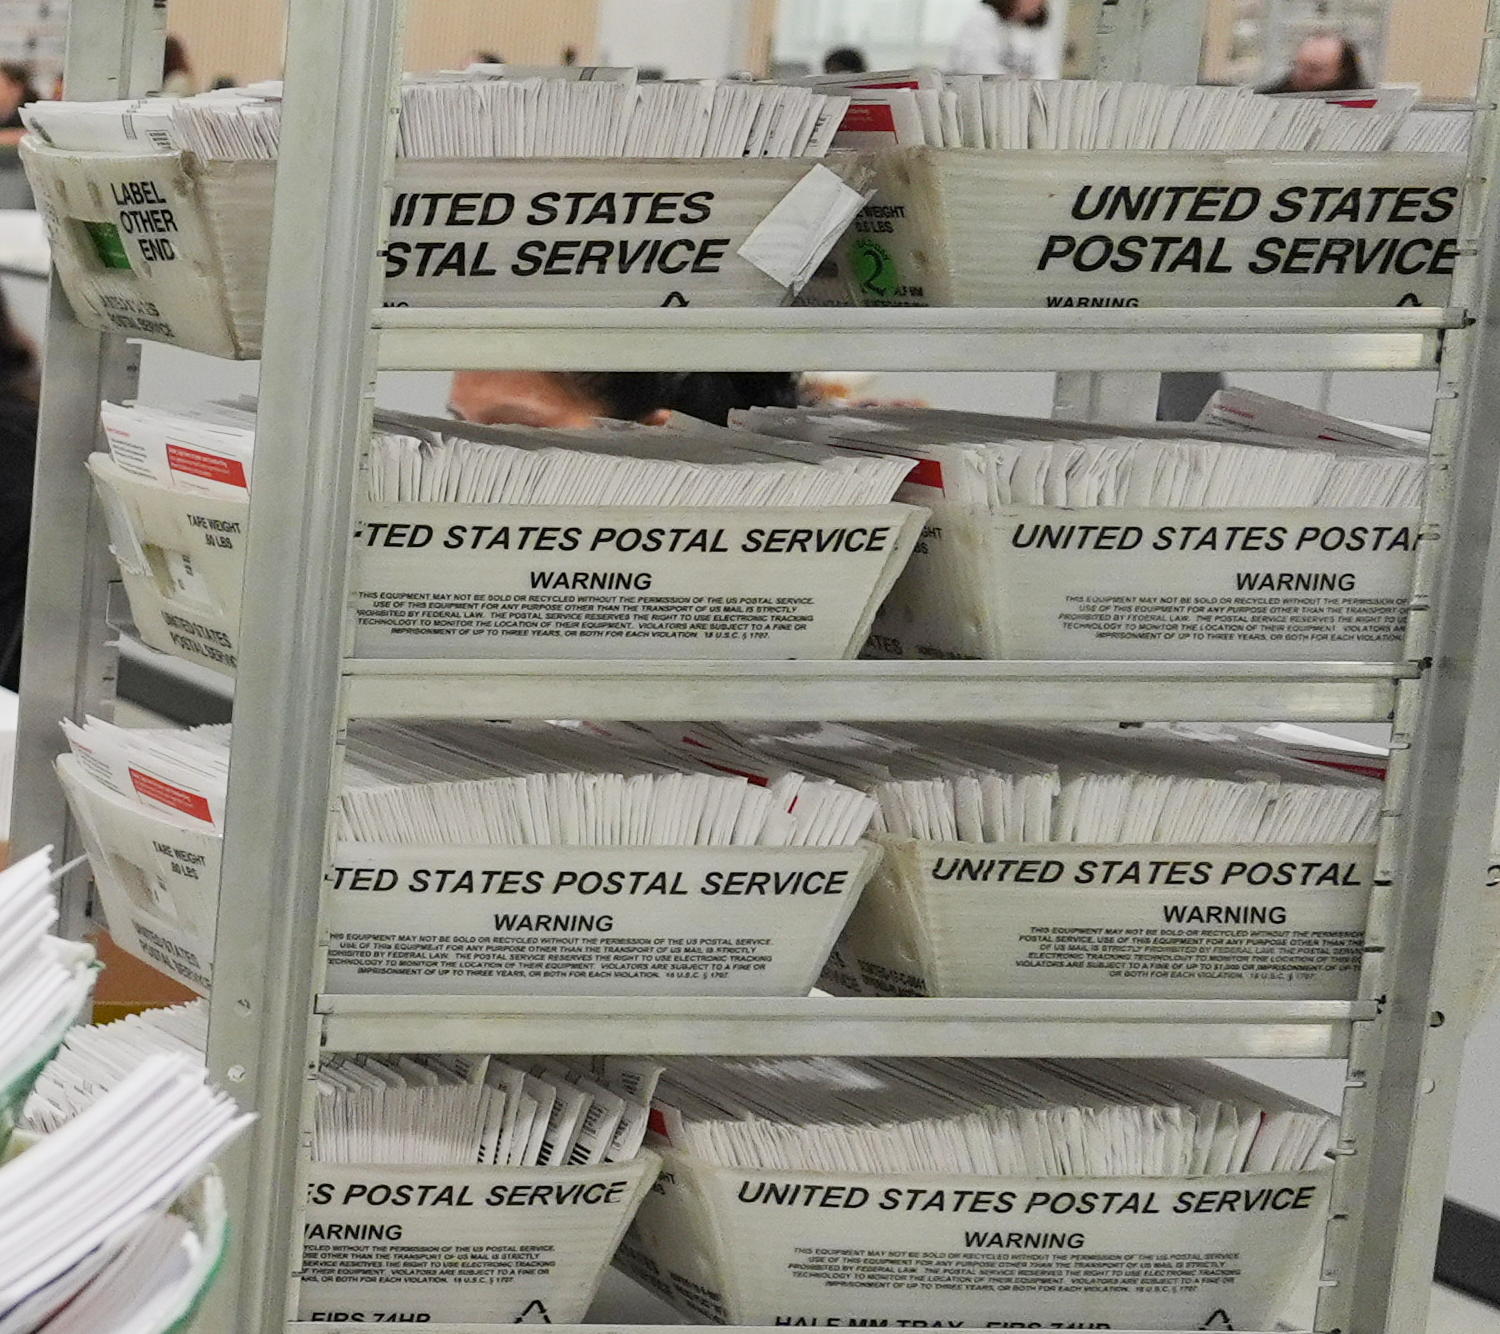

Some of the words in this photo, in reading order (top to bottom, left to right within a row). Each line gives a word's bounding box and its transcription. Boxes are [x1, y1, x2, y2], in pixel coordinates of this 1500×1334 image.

[110, 180, 167, 206] LABEL
[1071, 184, 1262, 222] UNITED
[1269, 186, 1459, 224] STATES
[119, 208, 179, 234] OTHER
[526, 191, 715, 226] STATES
[137, 237, 176, 262] END
[510, 238, 731, 277] SERVICE
[1036, 234, 1233, 274] POSTAL
[1248, 236, 1462, 276] SERVICE
[443, 524, 583, 552] STATES
[589, 527, 729, 553] POSTAL
[741, 526, 891, 553] SERVICE
[1011, 523, 1143, 550] UNITED
[1152, 526, 1288, 552] STATES
[1294, 526, 1410, 552] POSTA
[530, 571, 652, 591] WARNING
[1236, 572, 1356, 592] WARNING
[408, 869, 545, 895] STATES
[552, 870, 688, 896] POSTAL
[700, 870, 849, 896] SERVICE
[931, 857, 1065, 884] UNITED
[1073, 860, 1214, 886] STATES
[1220, 861, 1362, 887] POSTAL
[493, 913, 614, 932] WARNING
[1163, 905, 1287, 925] WARNING
[341, 1184, 474, 1207] POSTAL
[485, 1180, 628, 1207] SERVICE
[737, 1180, 870, 1209] UNITED
[878, 1188, 1018, 1214] STATES
[1024, 1192, 1160, 1215] POSTAL
[1172, 1185, 1317, 1214] SERVICE
[964, 1231, 1085, 1249] WARNING
